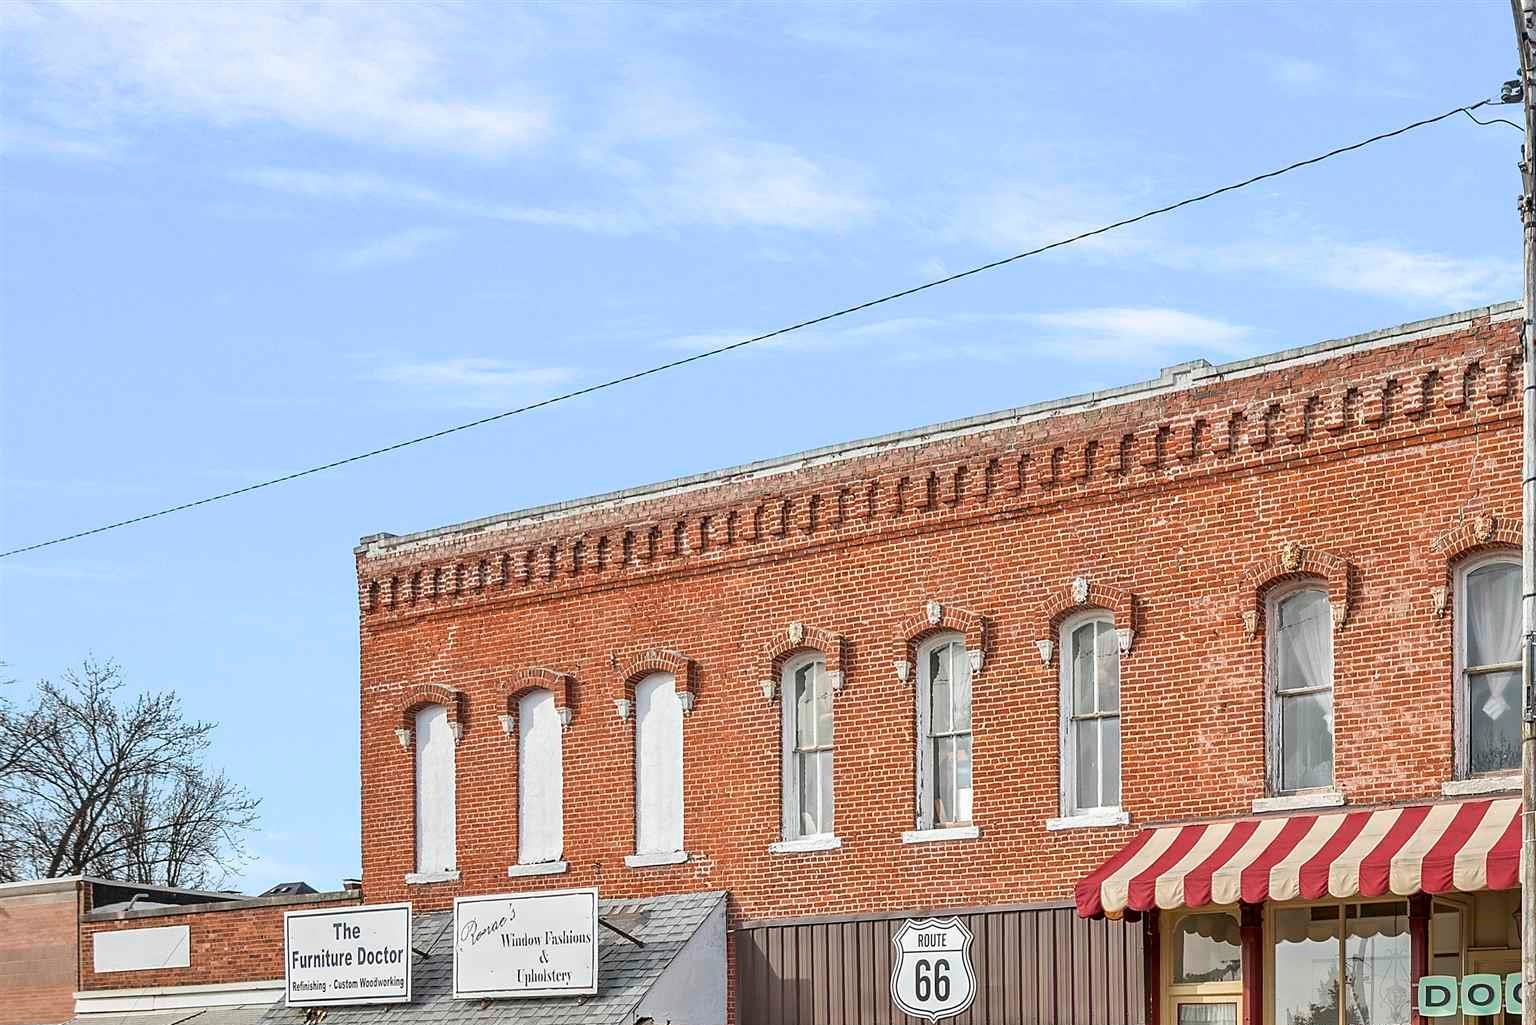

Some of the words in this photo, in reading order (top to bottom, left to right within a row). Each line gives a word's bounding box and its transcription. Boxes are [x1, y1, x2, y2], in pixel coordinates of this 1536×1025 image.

[333, 922, 361, 940] The
[501, 932, 541, 947] Window
[545, 930, 591, 945] Fashions
[918, 933, 947, 947] ROUTE
[292, 949, 352, 969] Furniture
[357, 946, 404, 965] Doctor
[539, 950, 549, 963] &
[292, 981, 326, 992] Refinishing
[333, 979, 358, 989] Custom
[359, 976, 404, 989] Woodworking
[517, 969, 572, 987] Upholstery
[915, 958, 950, 1001] 66
